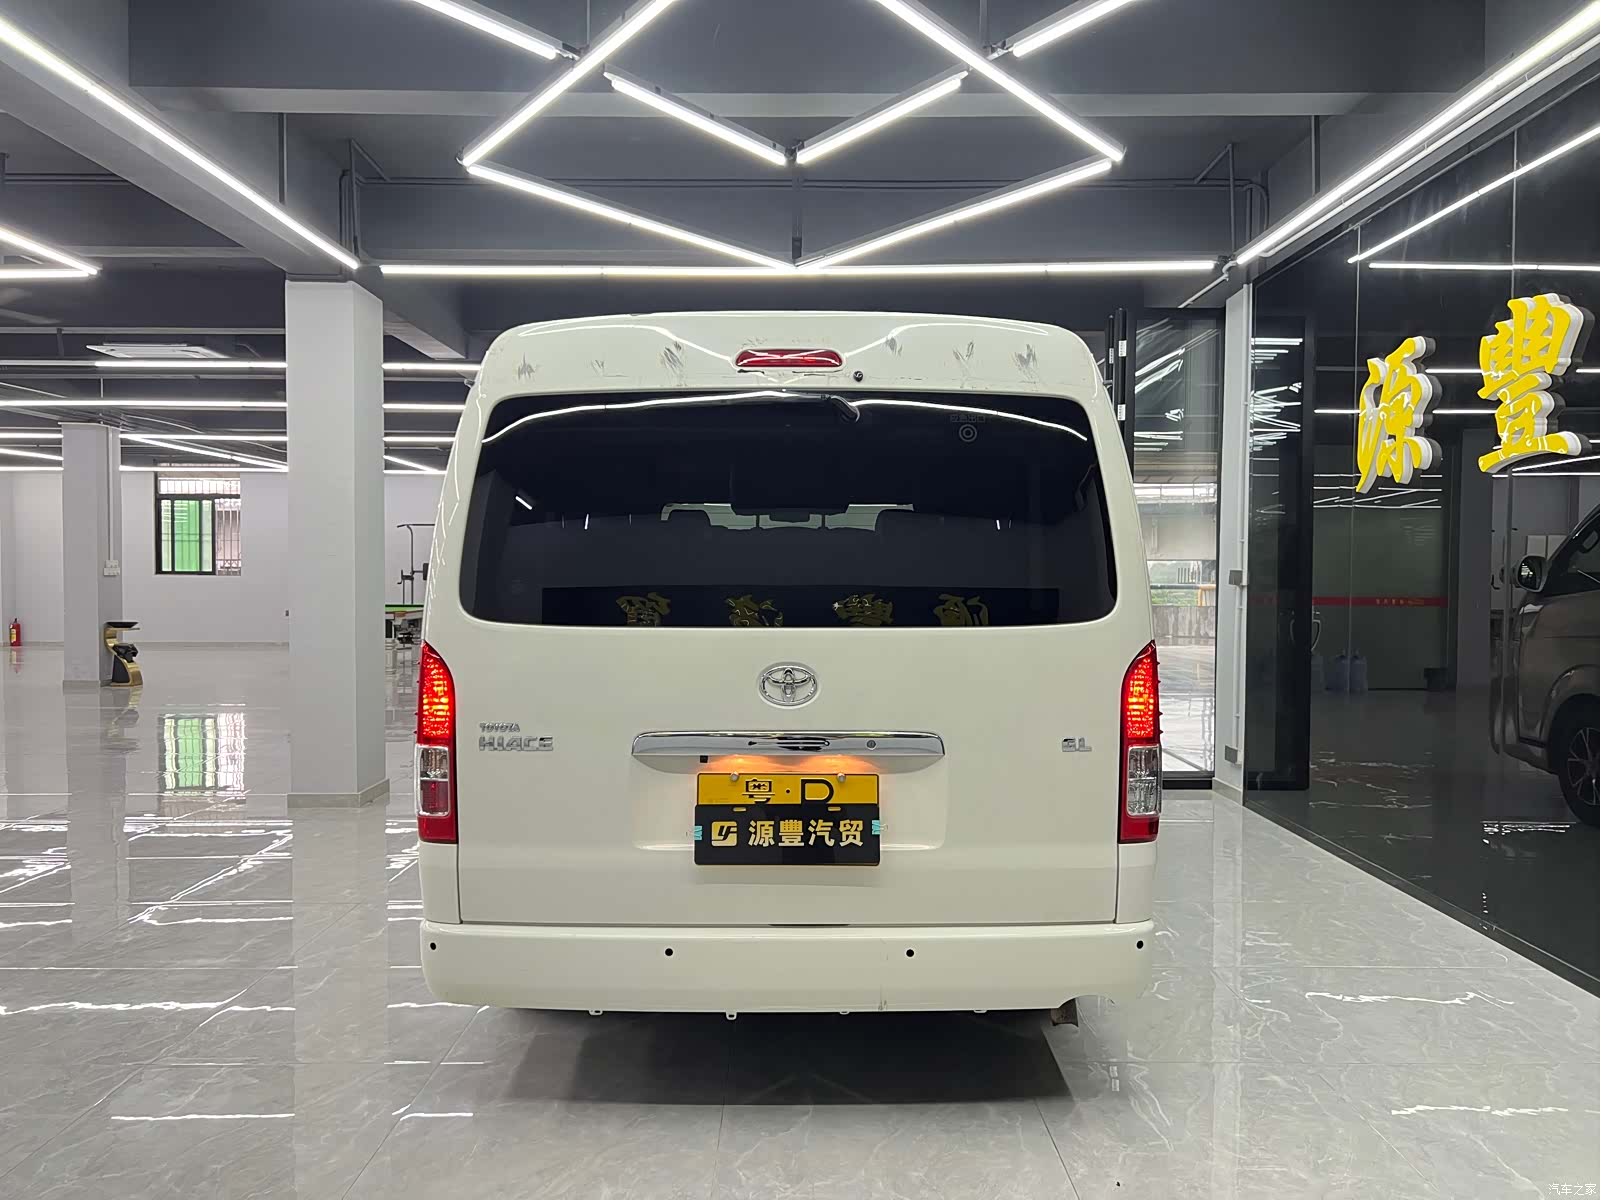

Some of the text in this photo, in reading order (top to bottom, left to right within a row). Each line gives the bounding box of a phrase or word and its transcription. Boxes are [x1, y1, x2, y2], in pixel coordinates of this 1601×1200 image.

[479, 722, 521, 733] TOYOTA
[478, 735, 554, 752] HIACE
[1061, 737, 1092, 752] GL
[748, 819, 865, 848] 源豐汽贸
